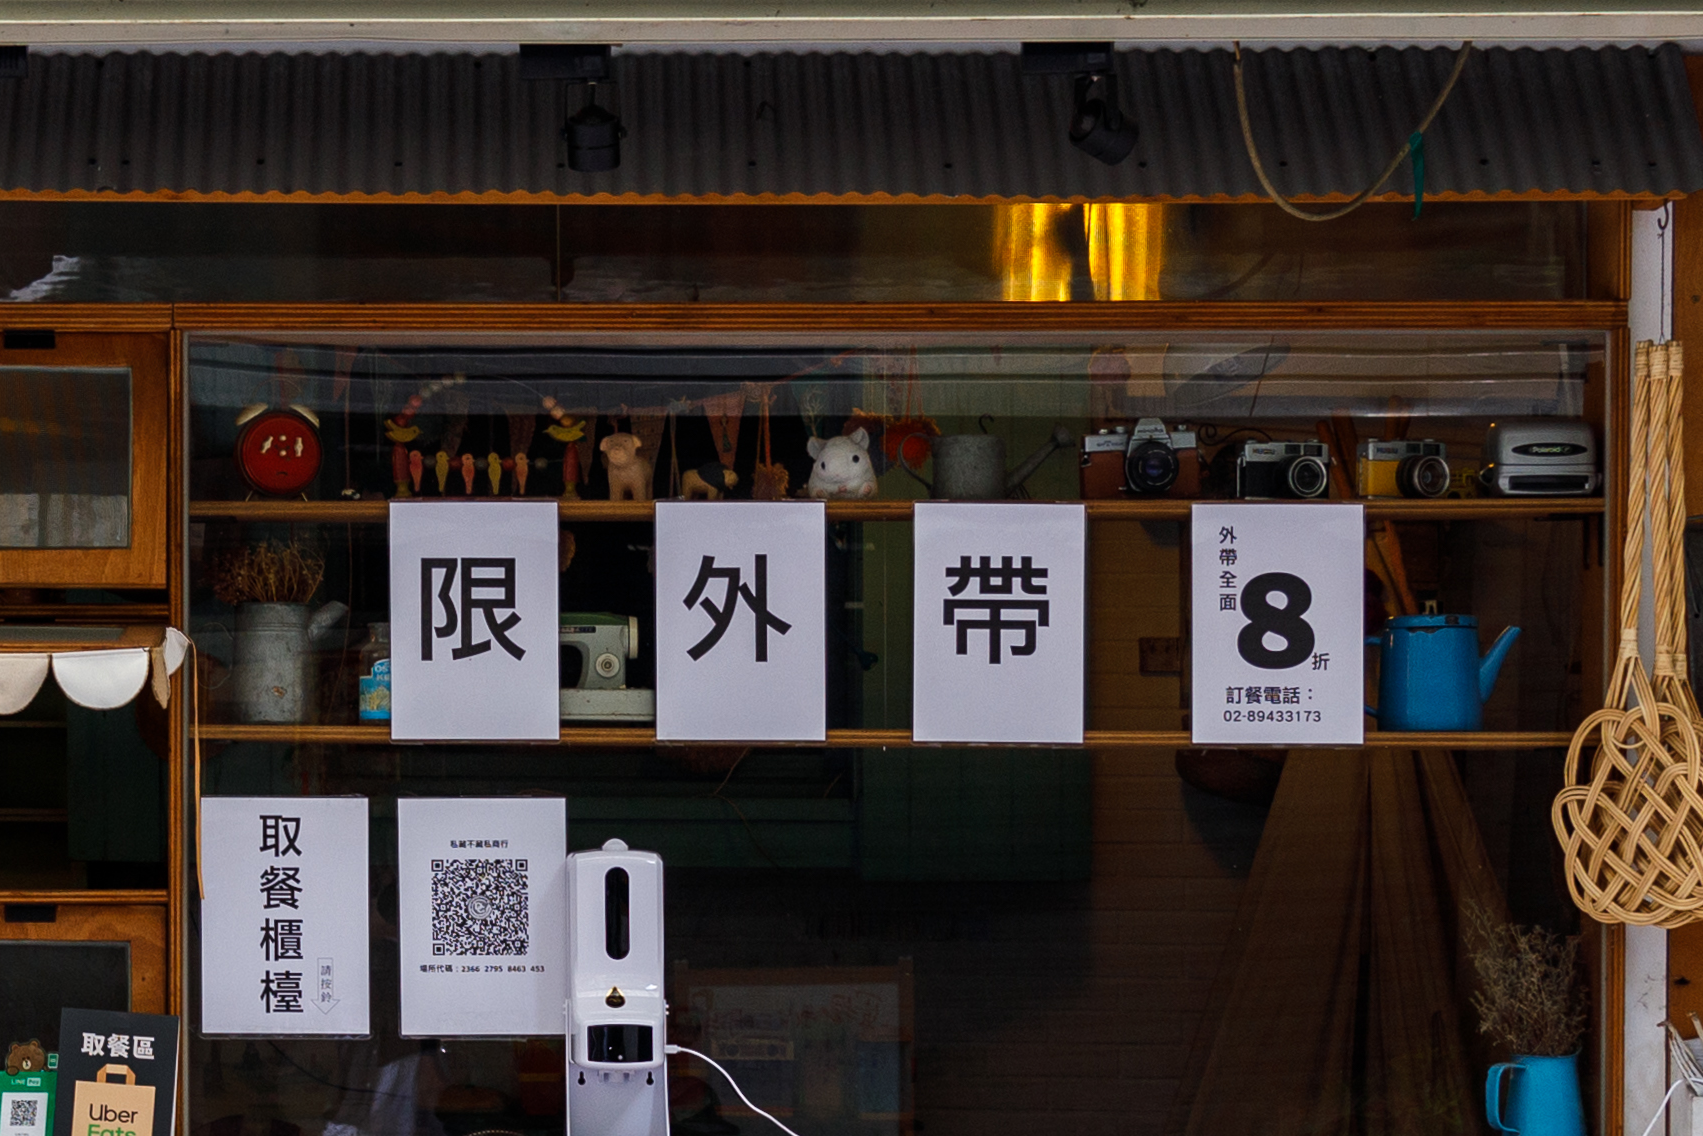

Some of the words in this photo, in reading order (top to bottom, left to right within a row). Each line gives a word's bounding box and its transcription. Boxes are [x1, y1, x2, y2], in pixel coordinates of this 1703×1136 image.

[1219, 526, 1237, 611] 外帶全面
[421, 557, 526, 661] 限
[682, 553, 792, 662] 外
[942, 556, 1049, 664] 帶
[1237, 571, 1315, 669] 8
[1312, 652, 1330, 671] 折
[1226, 686, 1313, 704] 訂餐電話：
[1223, 710, 1322, 722] 02-89433173
[259, 814, 304, 1014] 取餐櫃檯
[461, 965, 481, 973] 2366
[484, 965, 504, 973] 2795
[507, 965, 527, 973] 8463
[530, 965, 545, 973] 453
[81, 1031, 156, 1061] 取餐區
[89, 1103, 139, 1124] Uber
